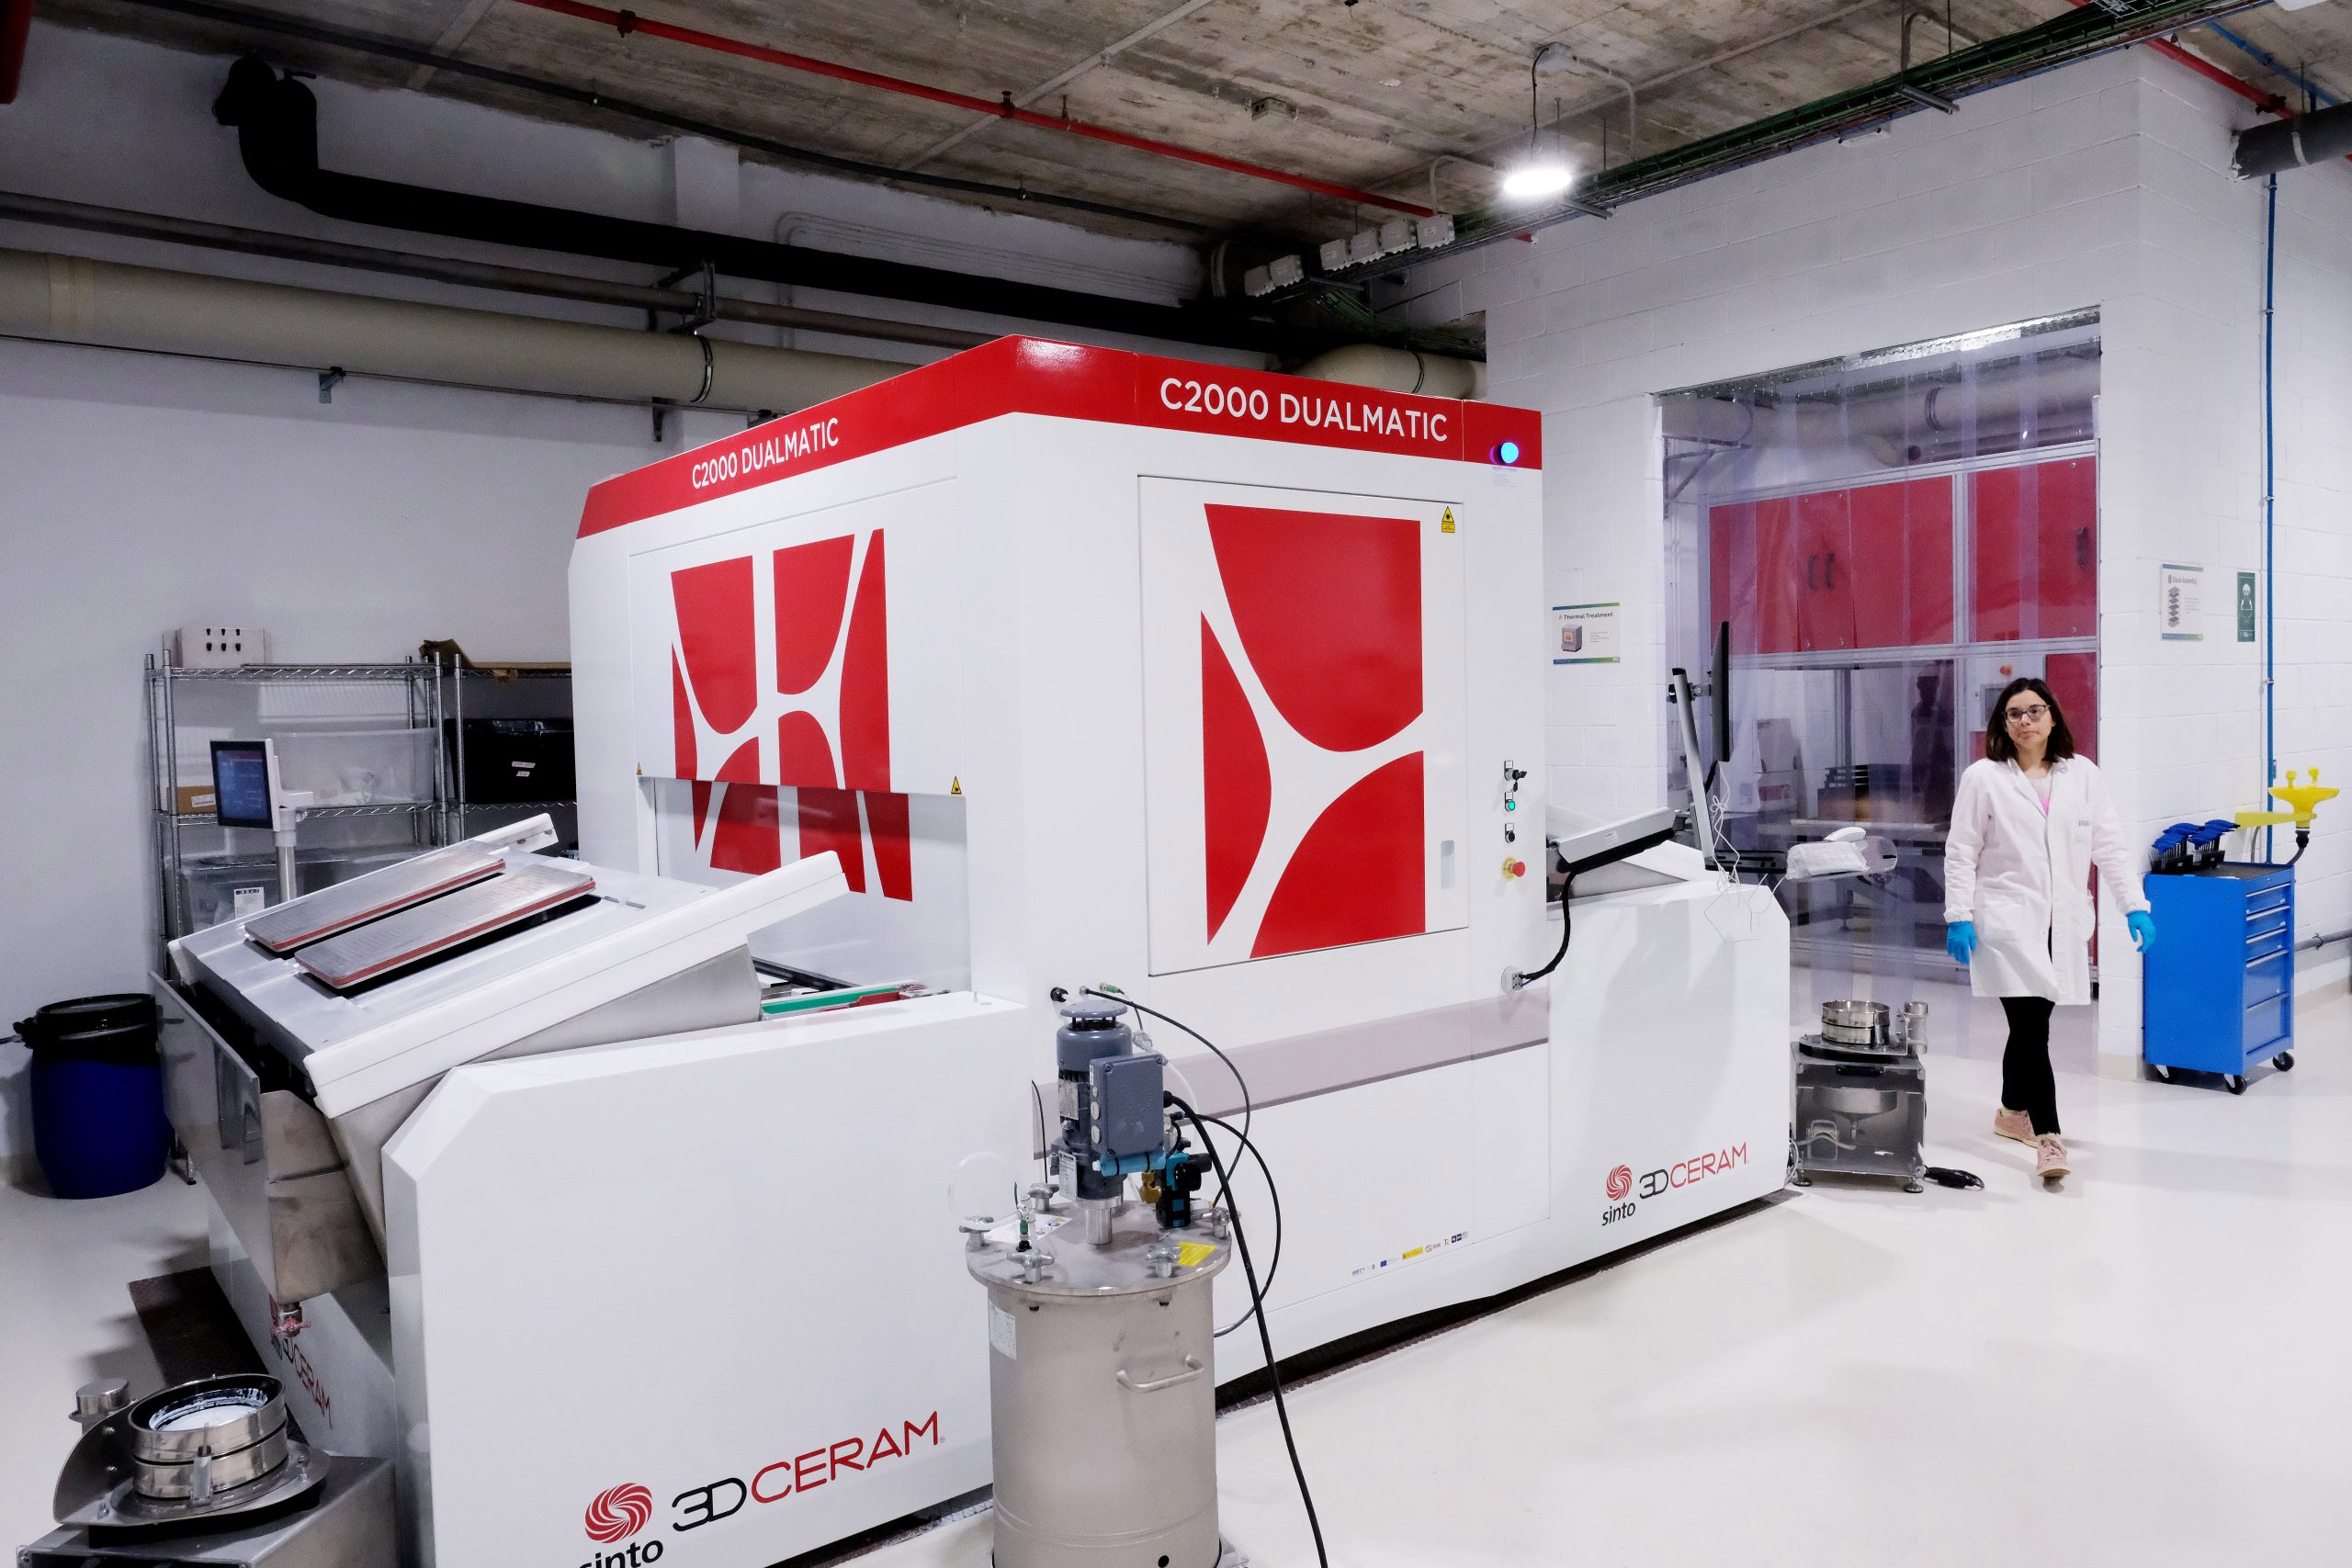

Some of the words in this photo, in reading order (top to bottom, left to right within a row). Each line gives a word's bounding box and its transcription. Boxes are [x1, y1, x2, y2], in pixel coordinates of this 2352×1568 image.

[1160, 378, 1269, 421] C2000
[1280, 393, 1448, 442] DUALMATIC
[692, 452, 738, 490] C2000
[741, 417, 839, 474] DUALMATIC
[1601, 1201, 1636, 1226] sinto
